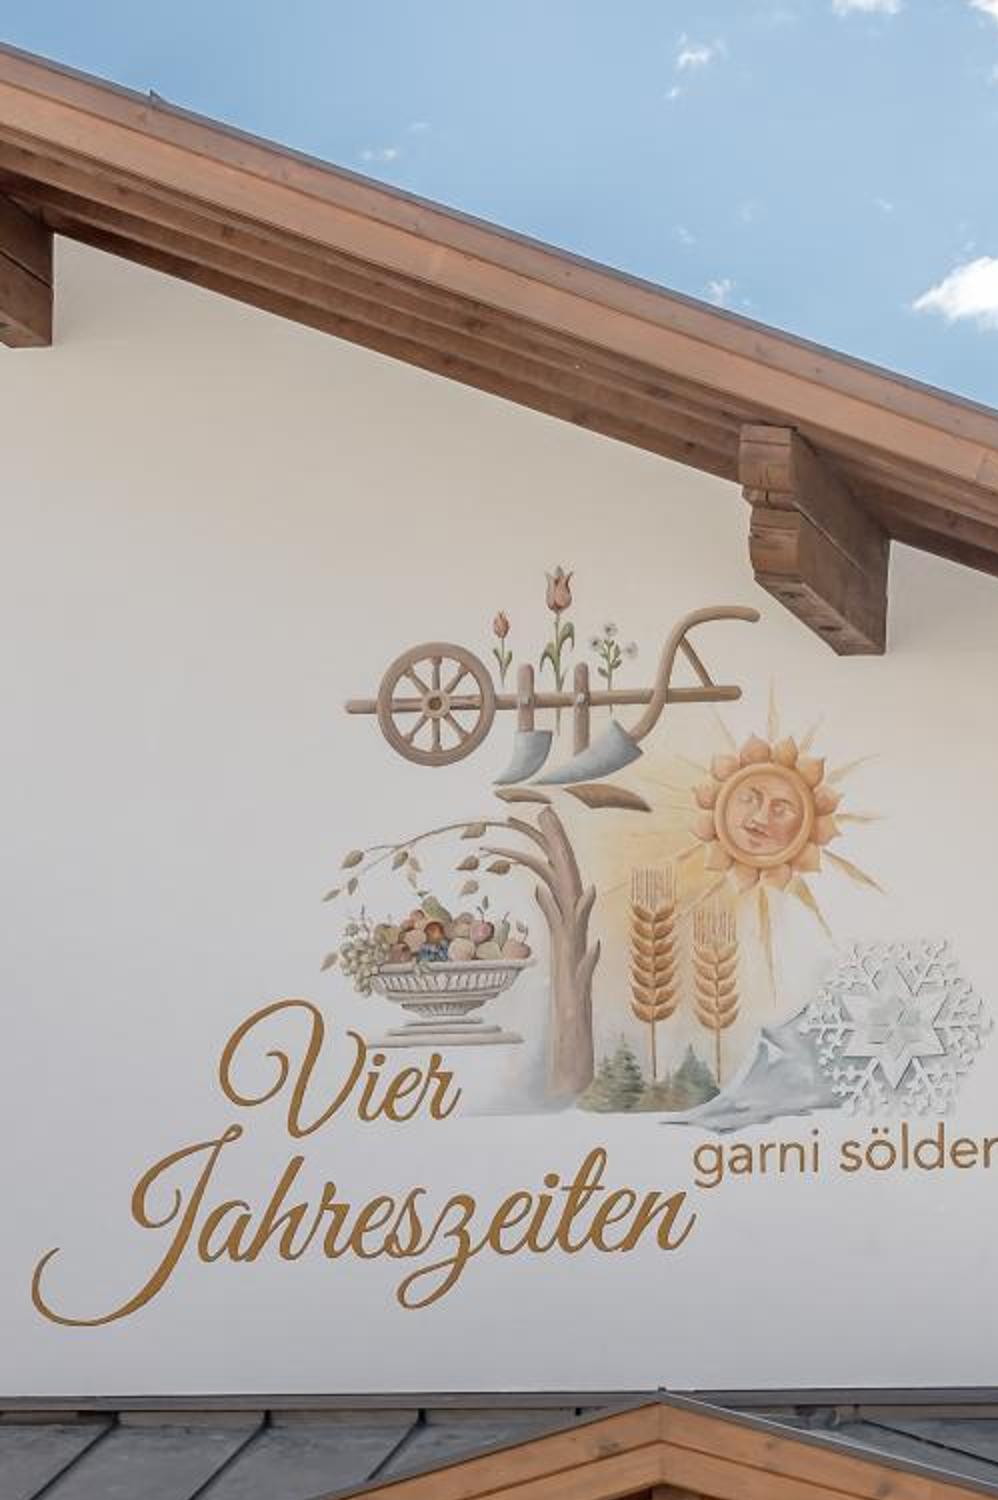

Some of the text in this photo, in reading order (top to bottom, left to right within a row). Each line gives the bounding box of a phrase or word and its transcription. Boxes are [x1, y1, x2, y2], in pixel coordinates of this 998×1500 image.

[218, 1000, 461, 1138] Vier
[31, 1124, 696, 1327] Jahreszeiten
[692, 1128, 821, 1187] garni
